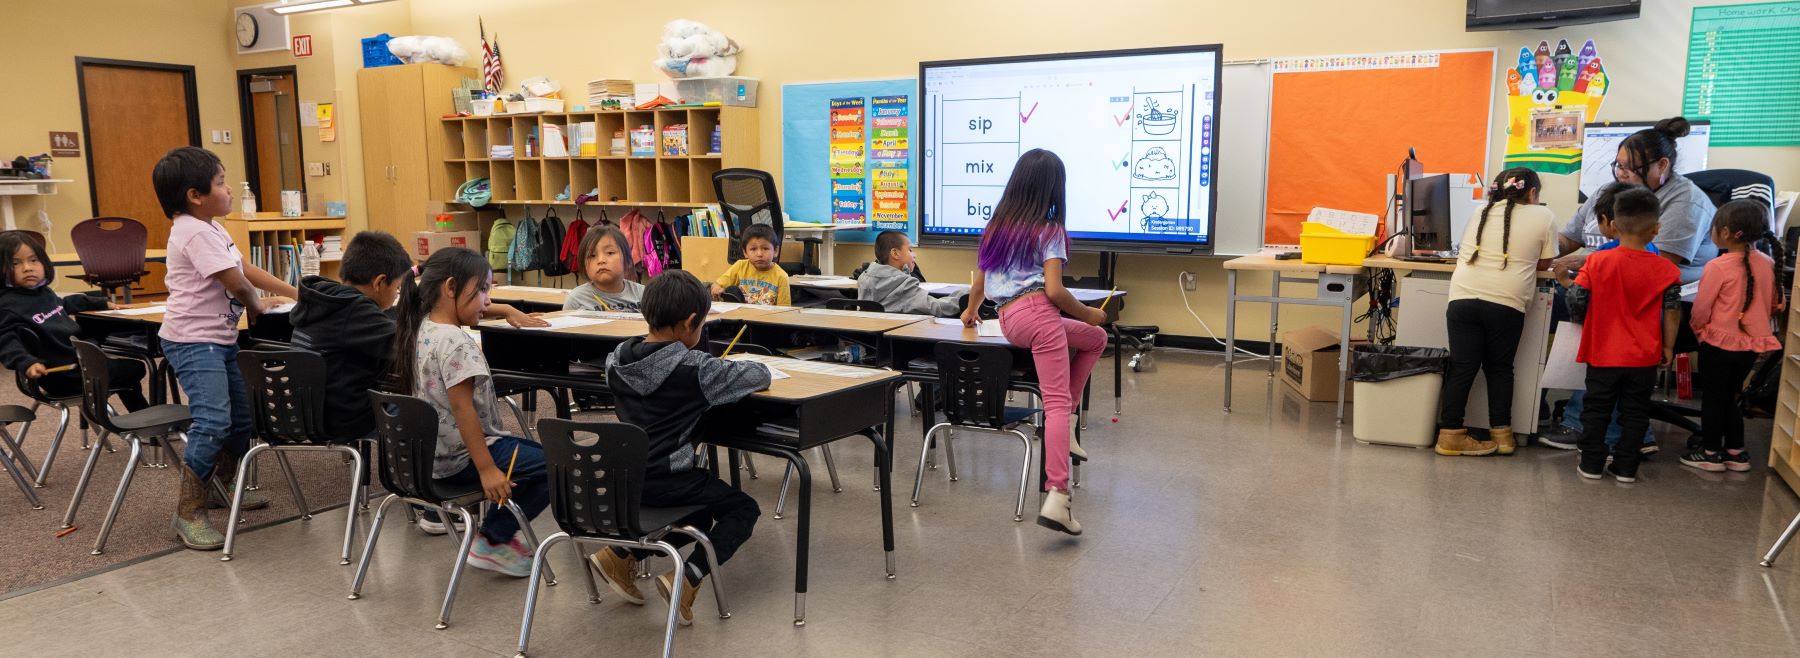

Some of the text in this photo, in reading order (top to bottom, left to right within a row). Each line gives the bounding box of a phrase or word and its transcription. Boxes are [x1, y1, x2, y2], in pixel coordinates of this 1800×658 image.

[1719, 8, 1776, 16] Homework
[294, 37, 310, 55] EXIT
[968, 117, 992, 134] sip
[831, 166, 862, 175] Wednesday
[965, 160, 994, 174] mix
[839, 200, 858, 209] Friday
[967, 198, 992, 220] big
